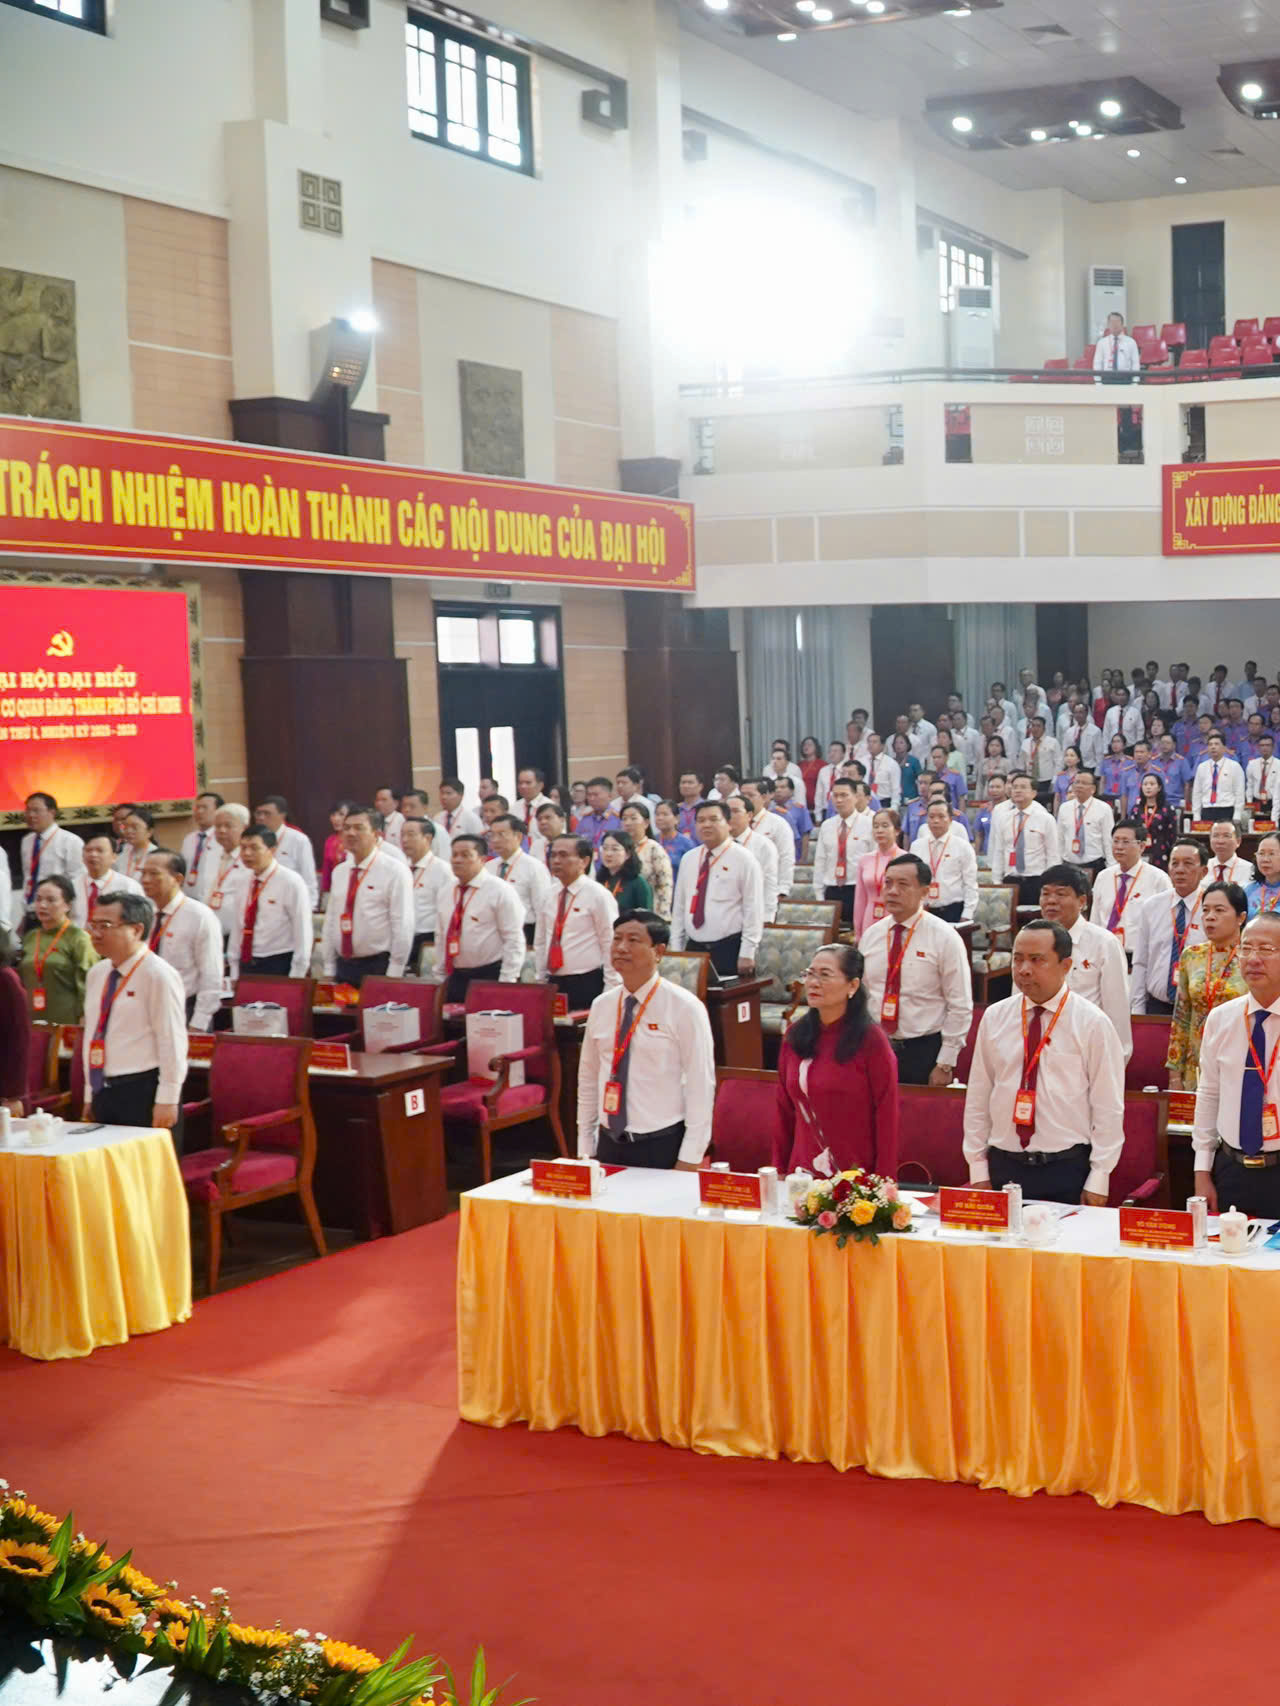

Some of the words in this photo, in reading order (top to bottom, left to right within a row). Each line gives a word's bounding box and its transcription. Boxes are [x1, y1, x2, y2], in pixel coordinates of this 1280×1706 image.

[111, 464, 215, 541] NHIỆM
[222, 474, 300, 538] HOÀN
[306, 483, 391, 545] THÀNH
[397, 492, 445, 549] CÁC
[451, 497, 490, 562] NỘI
[495, 509, 552, 557] DUNG
[557, 503, 597, 561] CỦA
[601, 520, 632, 572] ĐẠI
[636, 517, 666, 574] HỘI
[1185, 491, 1209, 526] XÂY
[1212, 492, 1246, 532] DỰNG
[20, 668, 55, 692] HỘI
[57, 672, 92, 691] ĐẠI
[94, 664, 137, 688] BIỂU
[410, 1095, 418, 1111] B
